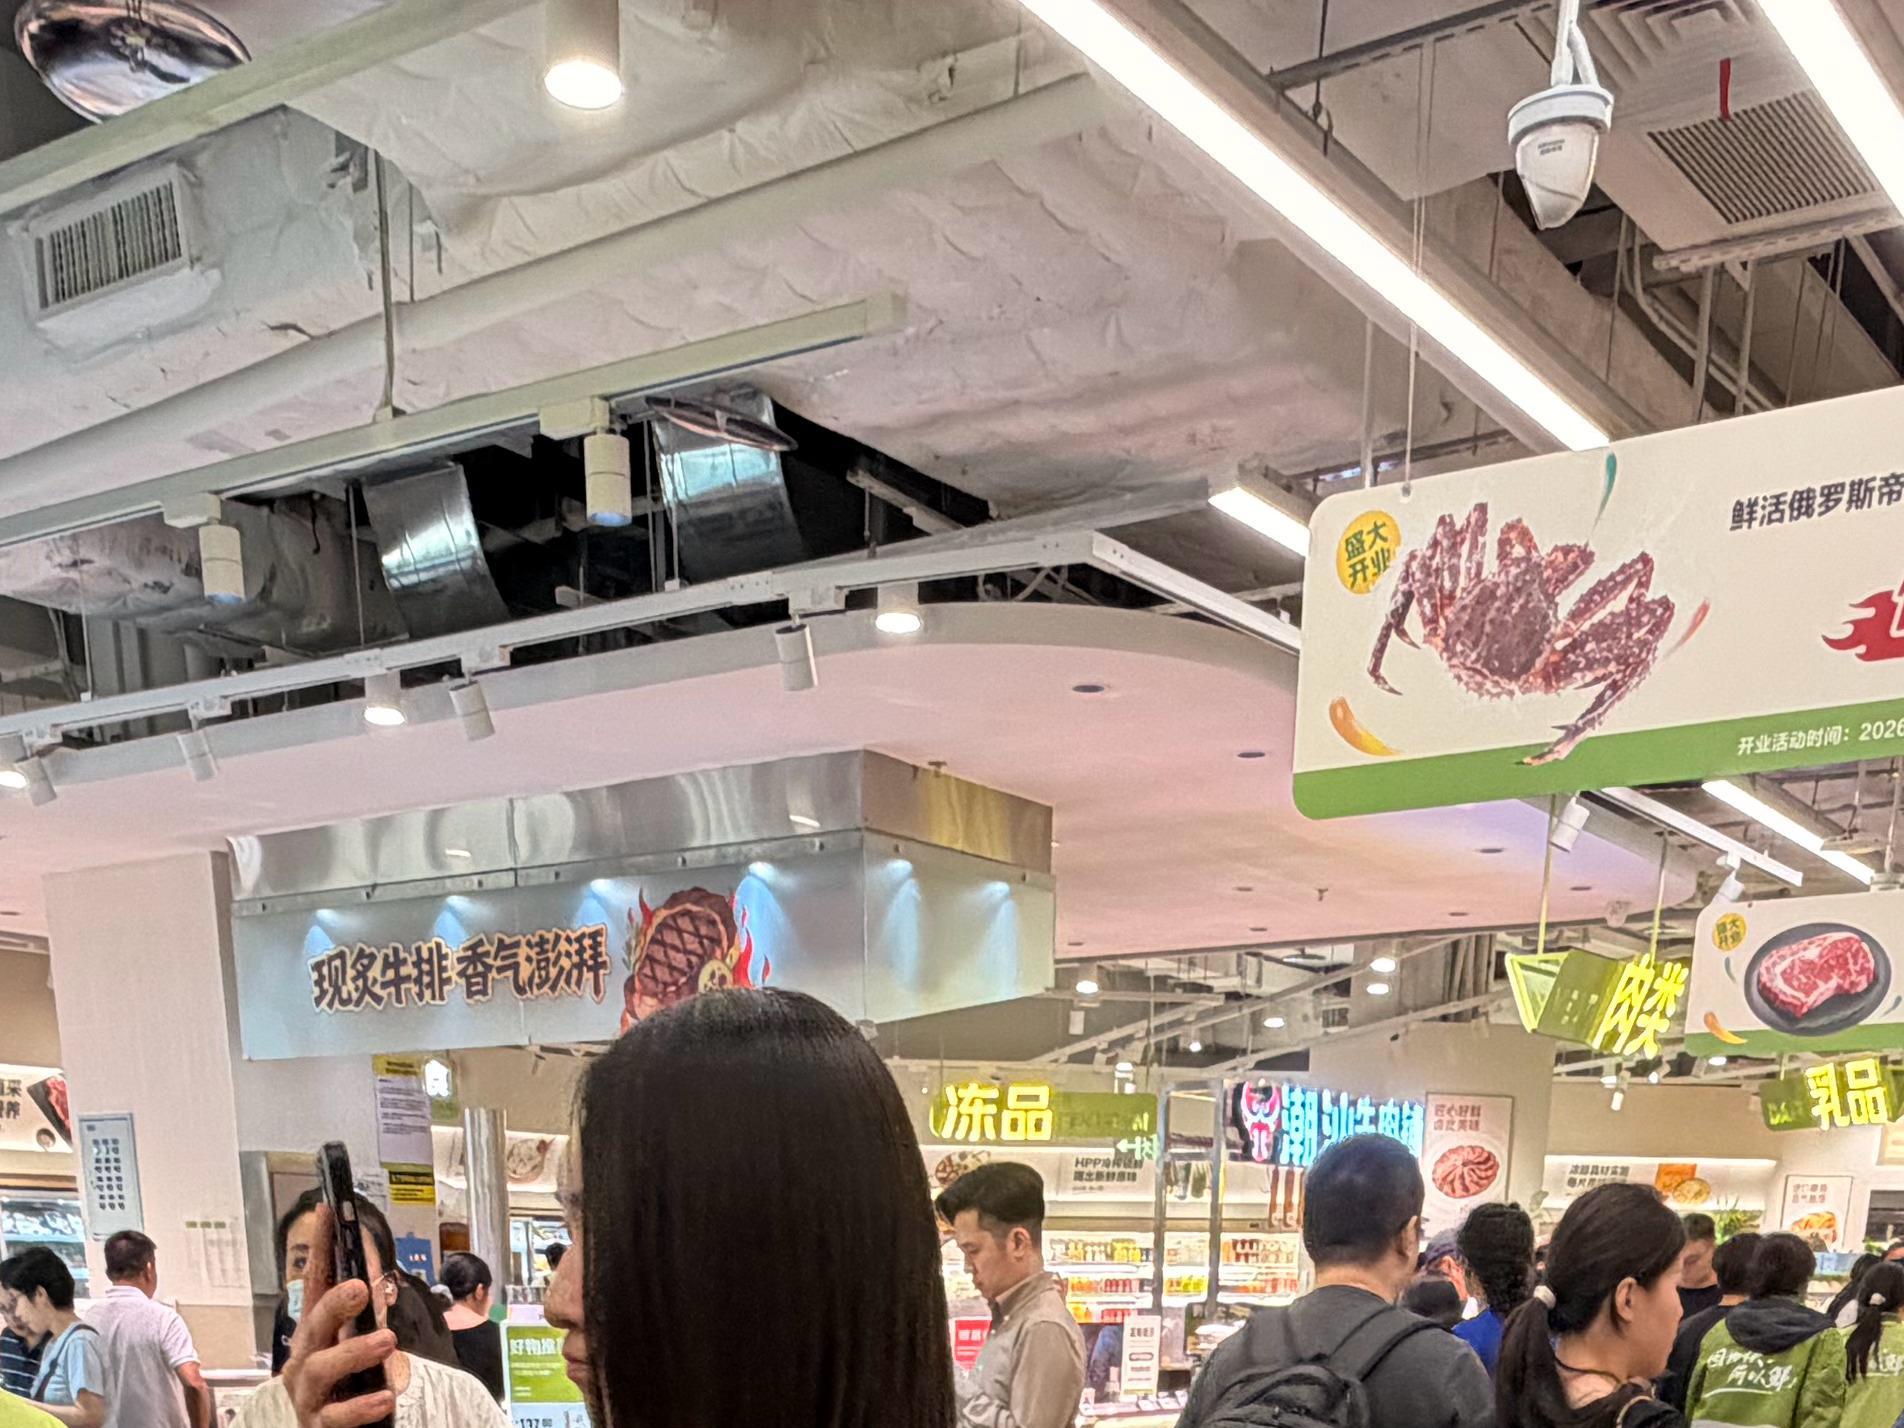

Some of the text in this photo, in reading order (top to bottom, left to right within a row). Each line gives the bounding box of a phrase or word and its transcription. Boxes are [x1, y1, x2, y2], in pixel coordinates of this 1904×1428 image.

[1343, 521, 1389, 564] 盛大
[1348, 549, 1395, 590] 开业
[310, 924, 609, 1011] 现炙牛排 香气澎湃
[1592, 953, 1689, 1059] 肉类
[942, 1083, 1052, 1142] 冻品
[1805, 1058, 1888, 1131] 乳品
